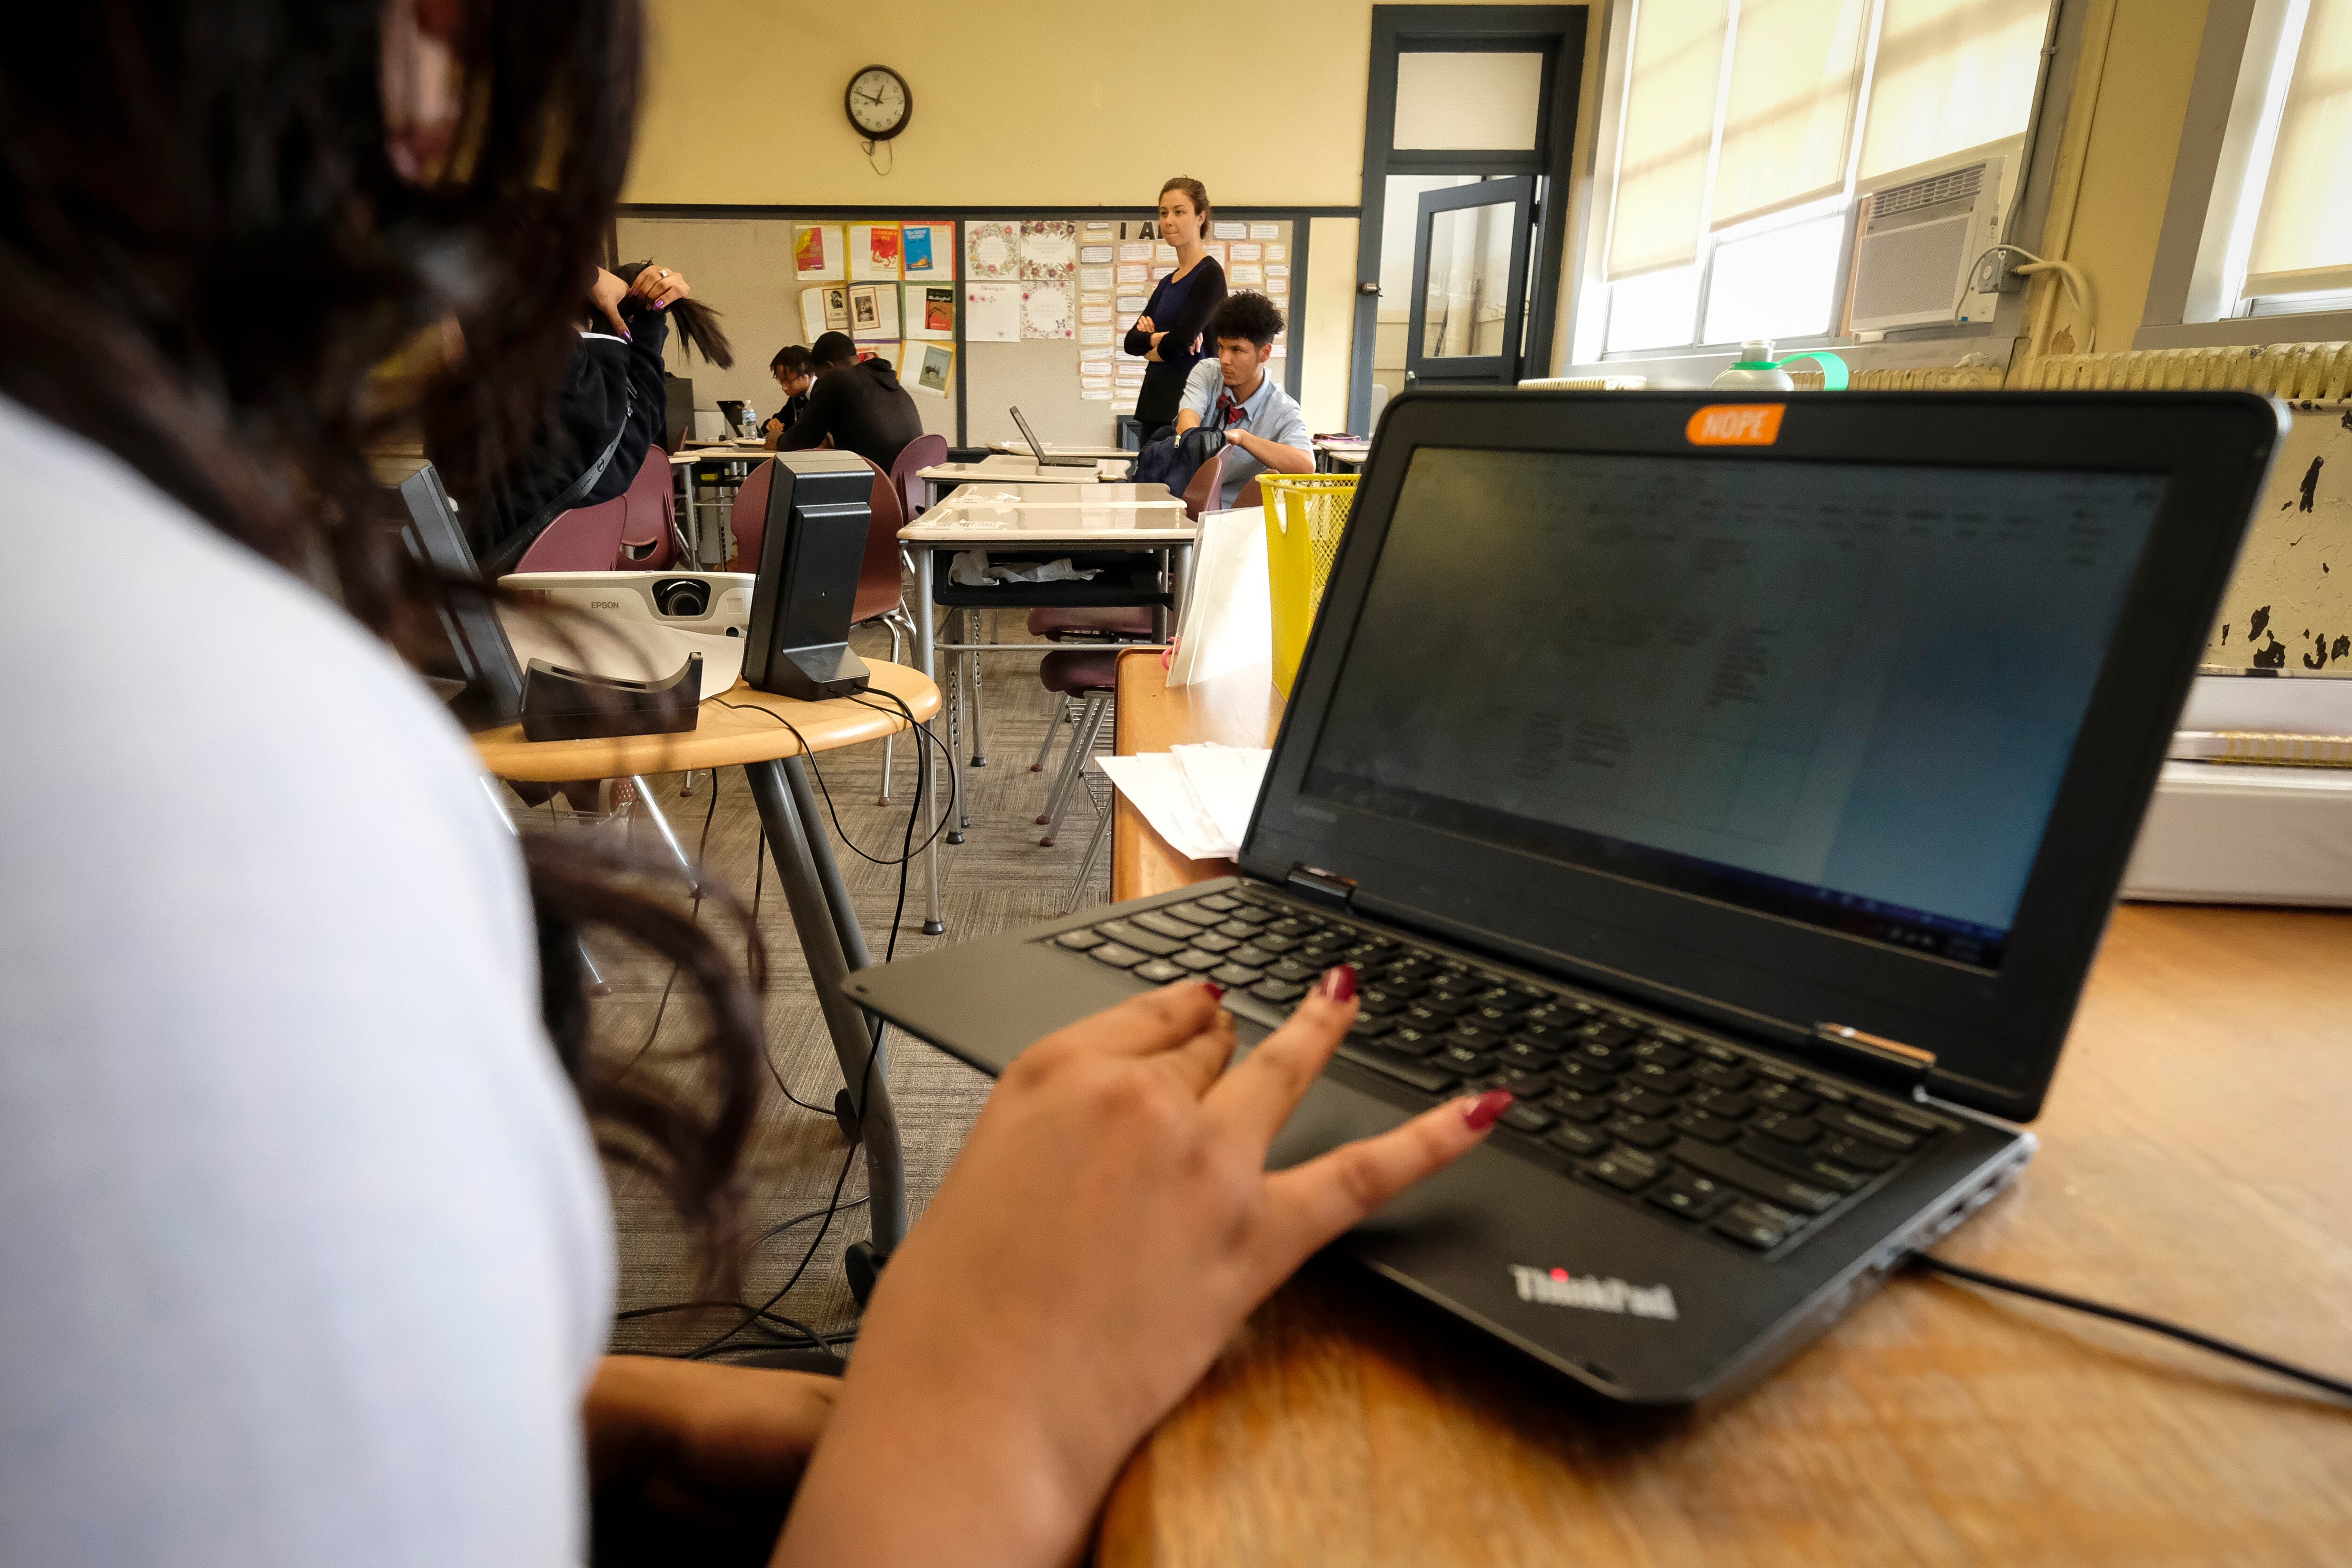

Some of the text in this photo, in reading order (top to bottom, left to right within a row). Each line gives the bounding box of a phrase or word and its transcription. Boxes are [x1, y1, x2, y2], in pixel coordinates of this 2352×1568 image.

[1120, 221, 1164, 240] I A
[1701, 410, 1768, 438] NOPE
[1507, 1264, 1679, 1321] ThinkPad
